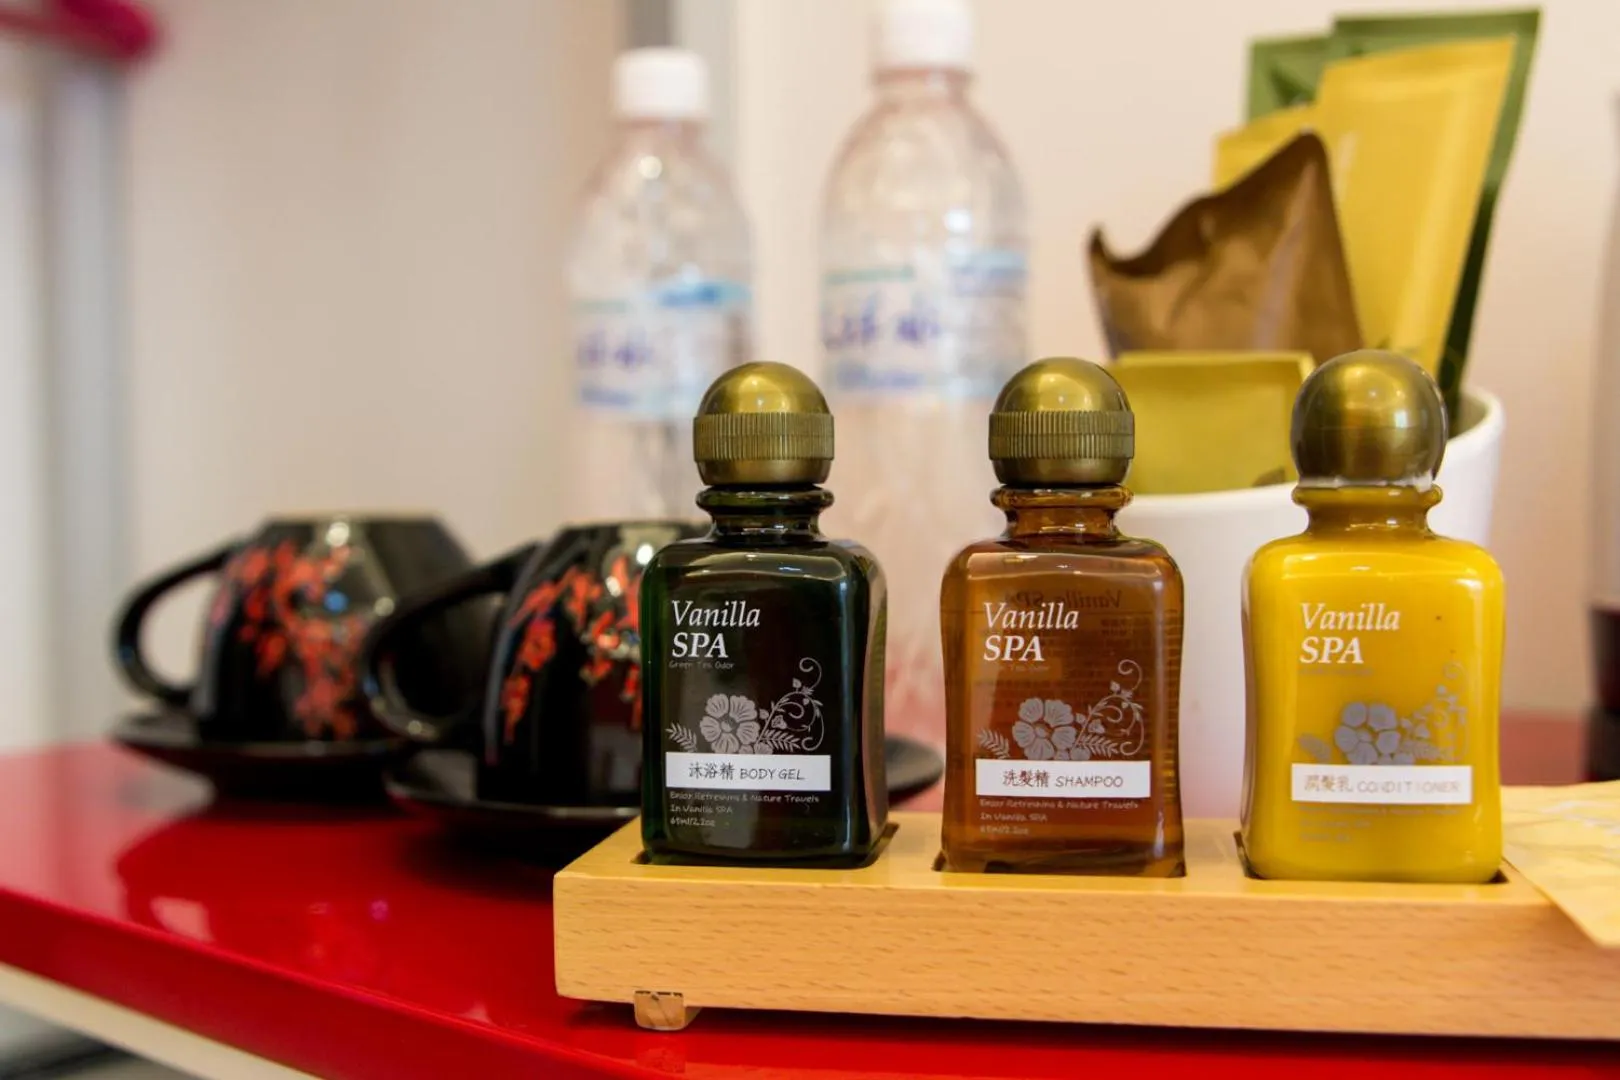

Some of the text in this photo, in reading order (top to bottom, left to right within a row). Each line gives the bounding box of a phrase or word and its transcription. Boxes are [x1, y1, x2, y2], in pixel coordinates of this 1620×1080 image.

[671, 600, 760, 627] Vanilla
[983, 602, 1079, 630] Vanilla
[1300, 602, 1401, 631] Vanilla
[672, 632, 729, 658] SPA
[983, 634, 1045, 661] SPA
[1299, 636, 1364, 664] SPA
[688, 761, 806, 780] 沐浴精 BODY GEL
[1002, 769, 1124, 788] 洗髮精 SHAMPOO
[750, 794, 782, 803] Nature
[784, 794, 820, 803] Travels
[1357, 780, 1461, 793] CONDITIONER
[670, 804, 681, 813] In
[683, 804, 714, 813] Vanilla
